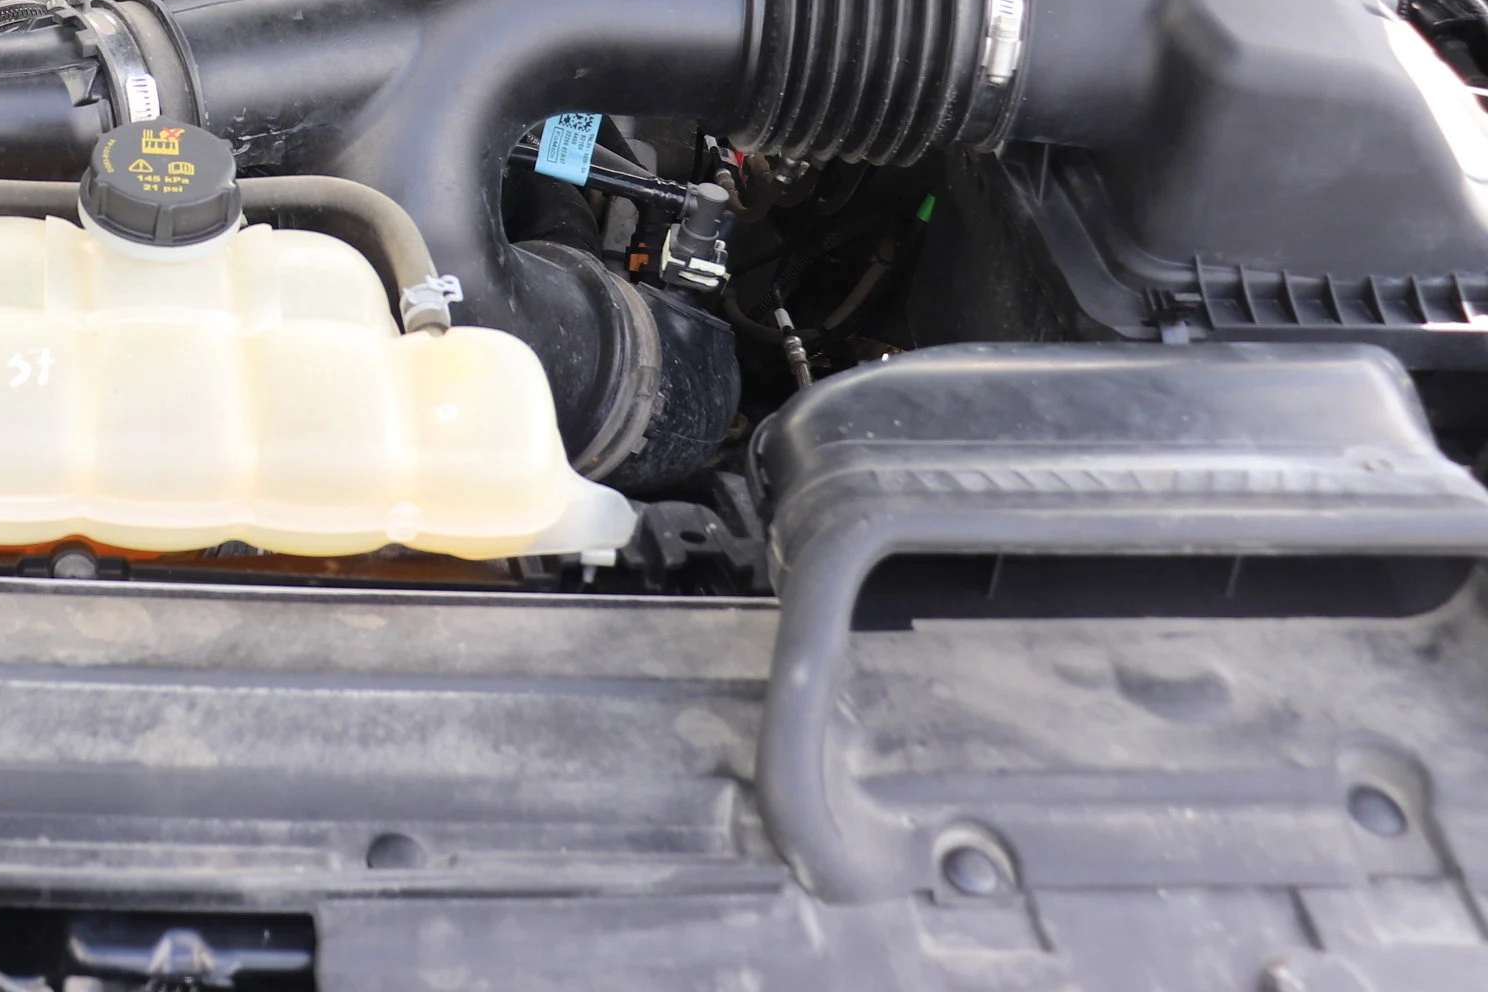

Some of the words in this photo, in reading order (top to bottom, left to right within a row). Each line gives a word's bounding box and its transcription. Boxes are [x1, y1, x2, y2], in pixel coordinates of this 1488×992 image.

[136, 174, 161, 183] 145
[164, 175, 190, 184] kPa
[142, 183, 158, 191] 21
[163, 185, 184, 193] psi
